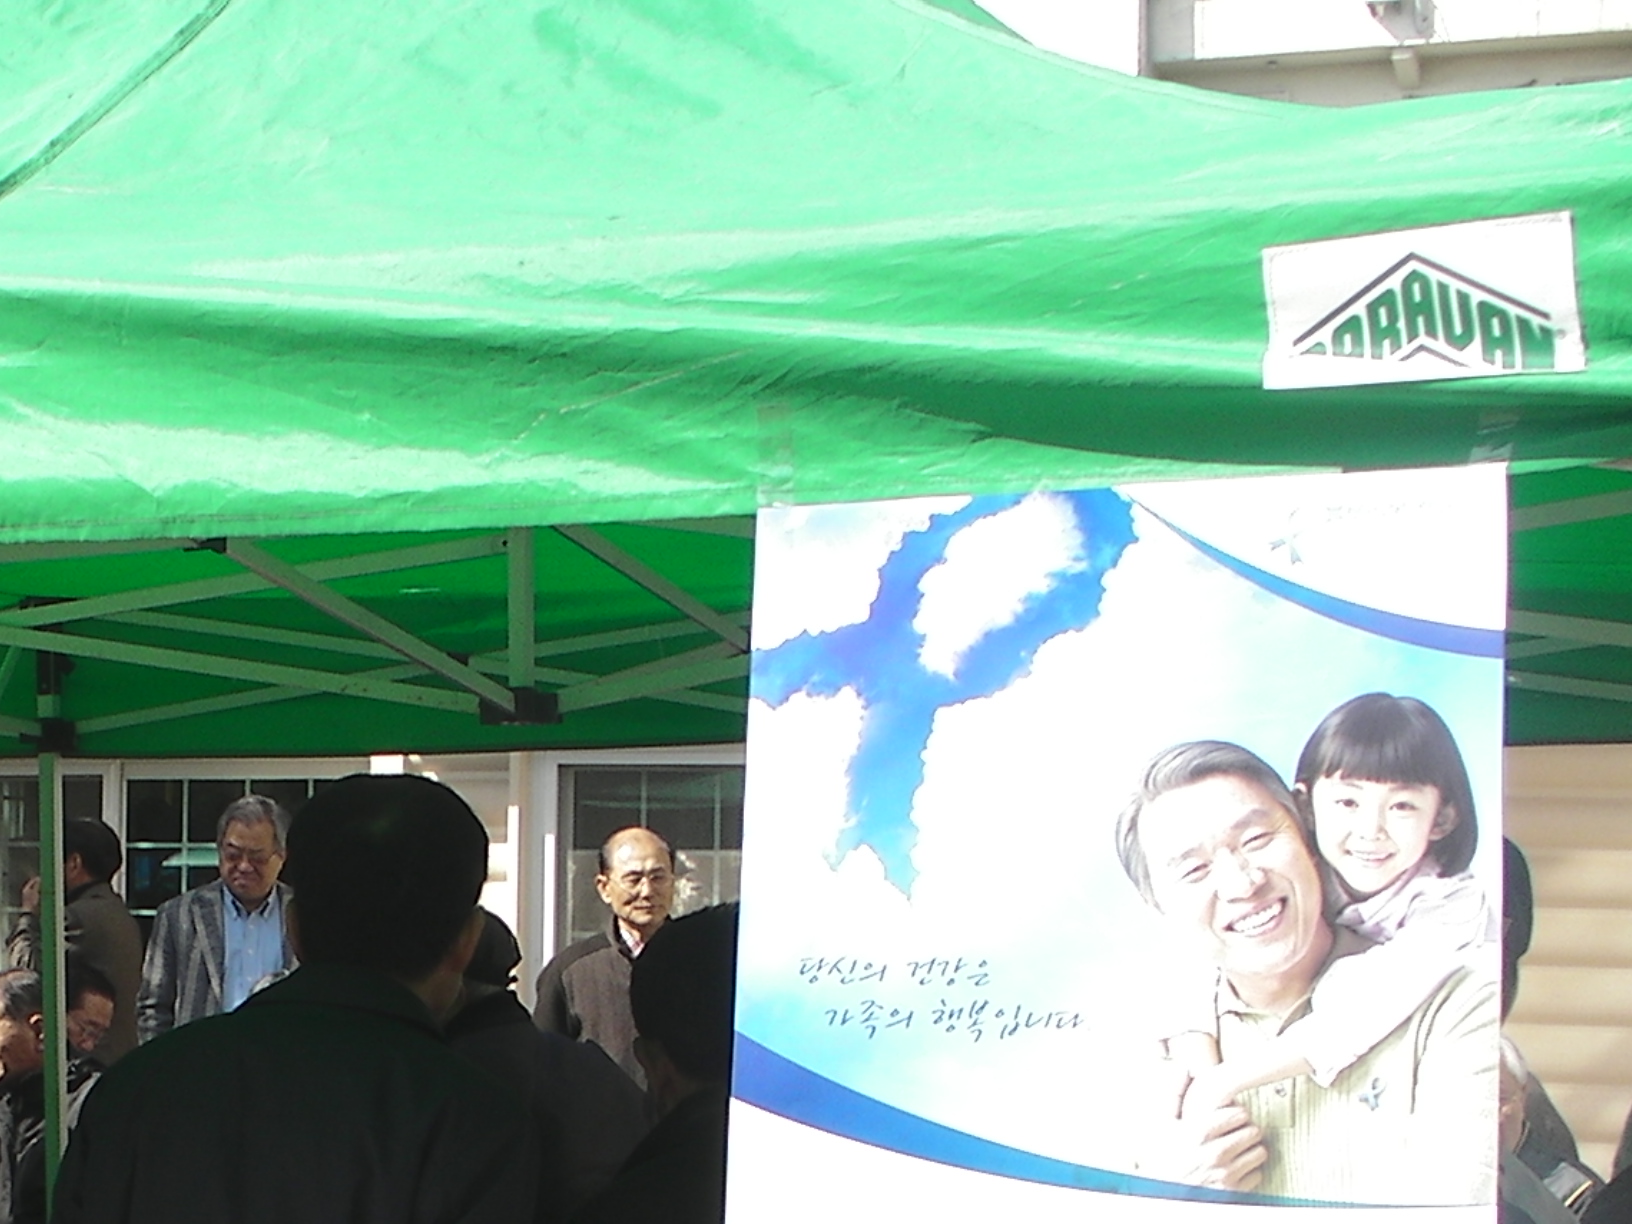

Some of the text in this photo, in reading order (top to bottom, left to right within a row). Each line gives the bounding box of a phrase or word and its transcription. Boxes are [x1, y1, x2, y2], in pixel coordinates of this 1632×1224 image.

[799, 956, 990, 986] 당신의 건강은
[824, 999, 914, 1039] 가족의
